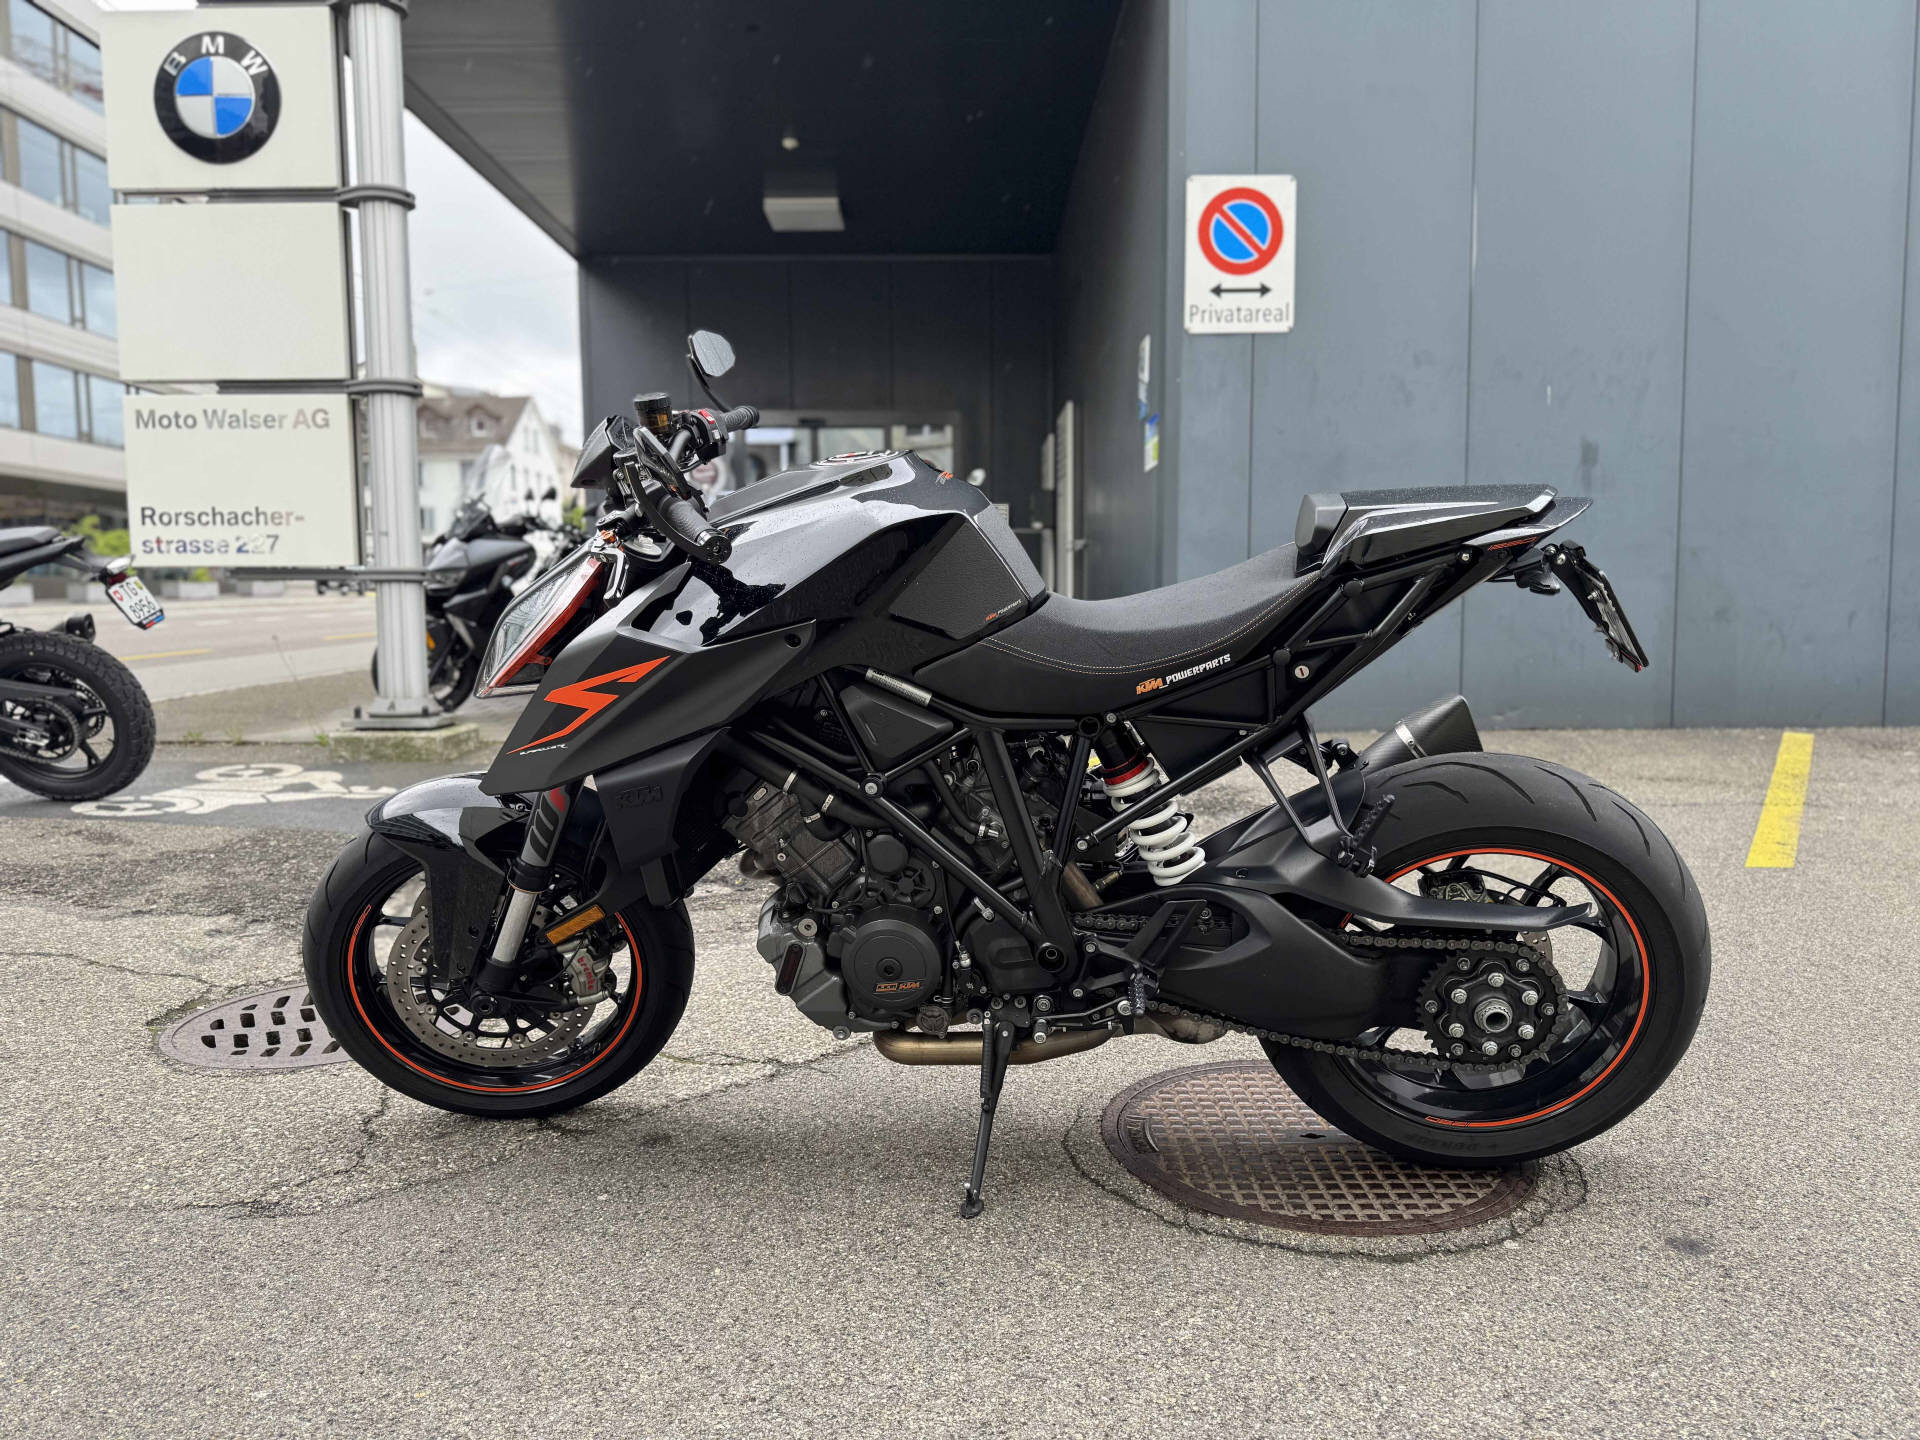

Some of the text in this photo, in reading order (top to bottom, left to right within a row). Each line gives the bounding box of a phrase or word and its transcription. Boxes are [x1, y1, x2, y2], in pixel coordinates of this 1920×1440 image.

[163, 34, 269, 77] BMW
[1189, 302, 1290, 323] Privatareal
[135, 408, 331, 430] Moto Walser AG
[140, 505, 305, 527] Rorschacher-
[142, 534, 280, 555] strasse 227
[119, 582, 139, 599] TG
[1136, 677, 1164, 695] KTM
